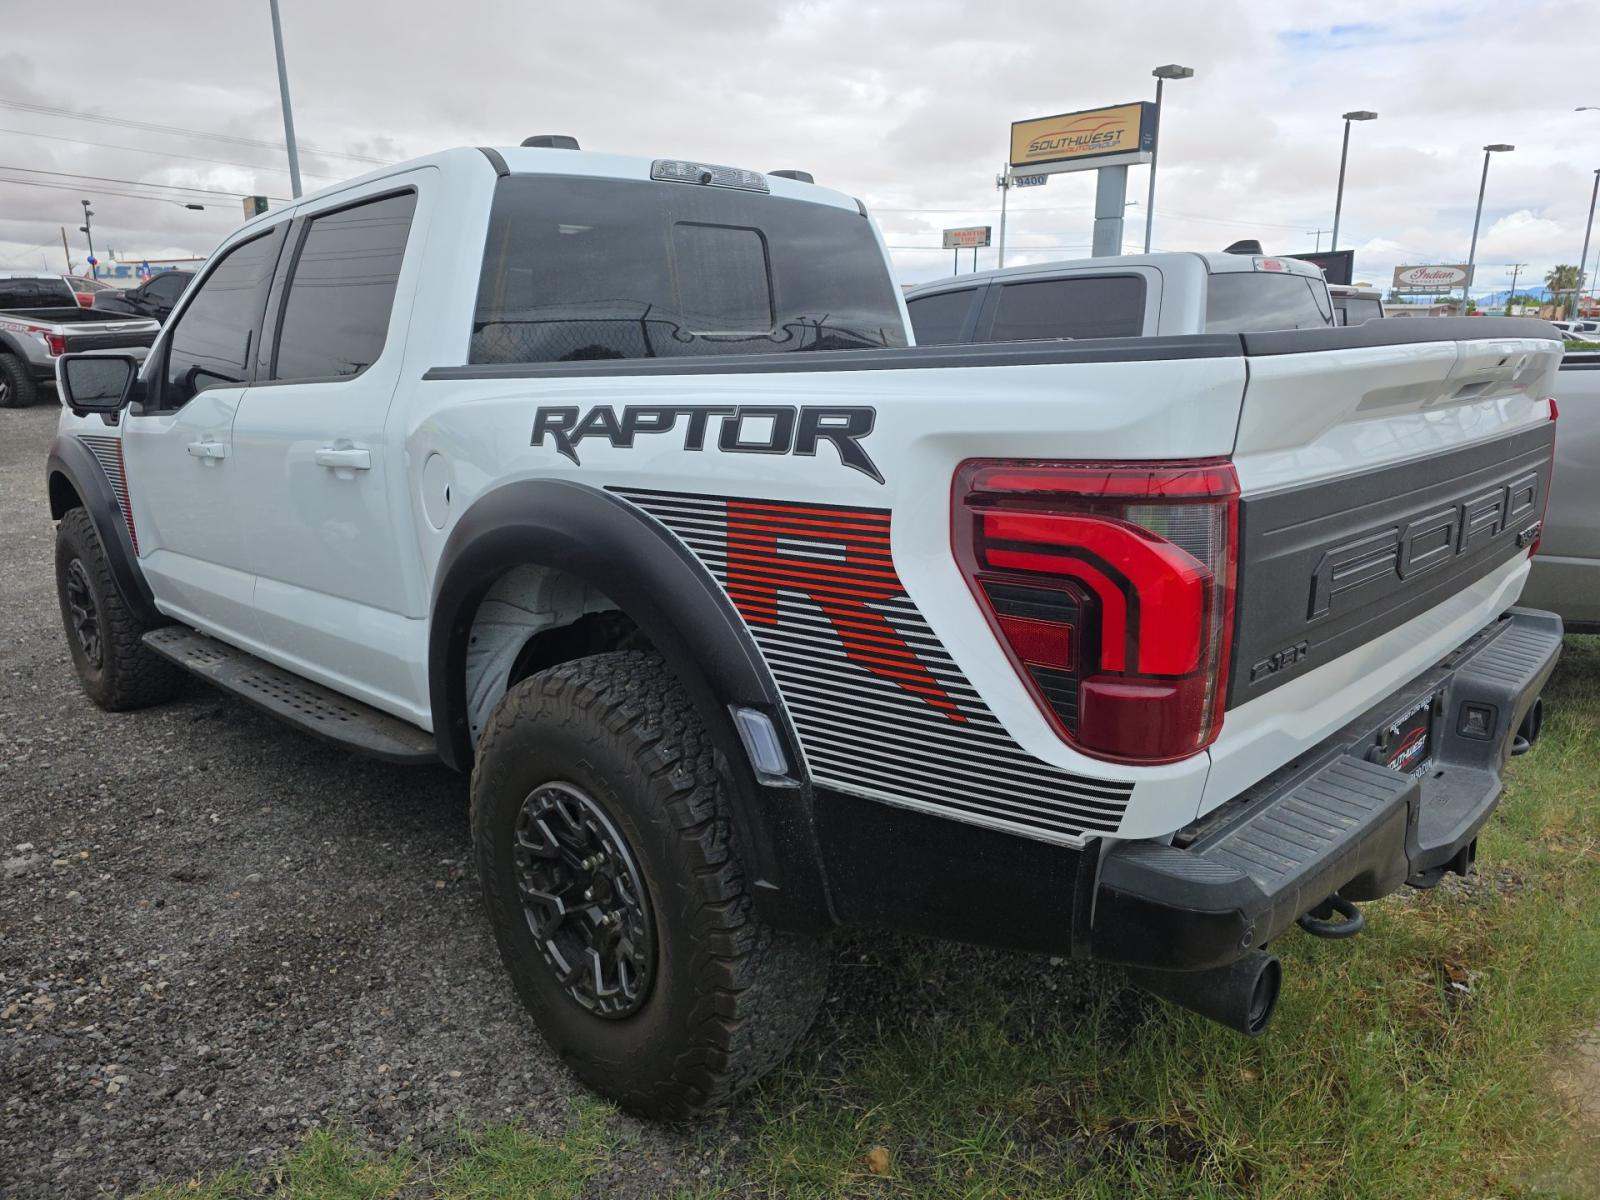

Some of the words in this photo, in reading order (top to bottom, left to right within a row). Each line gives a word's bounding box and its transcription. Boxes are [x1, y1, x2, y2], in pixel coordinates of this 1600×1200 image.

[1028, 129, 1125, 152] SOUTHWEST
[1016, 175, 1045, 187] 9400
[1410, 267, 1455, 280] Indian
[530, 404, 885, 486] RAPTOR
[1306, 470, 1539, 624] FORD
